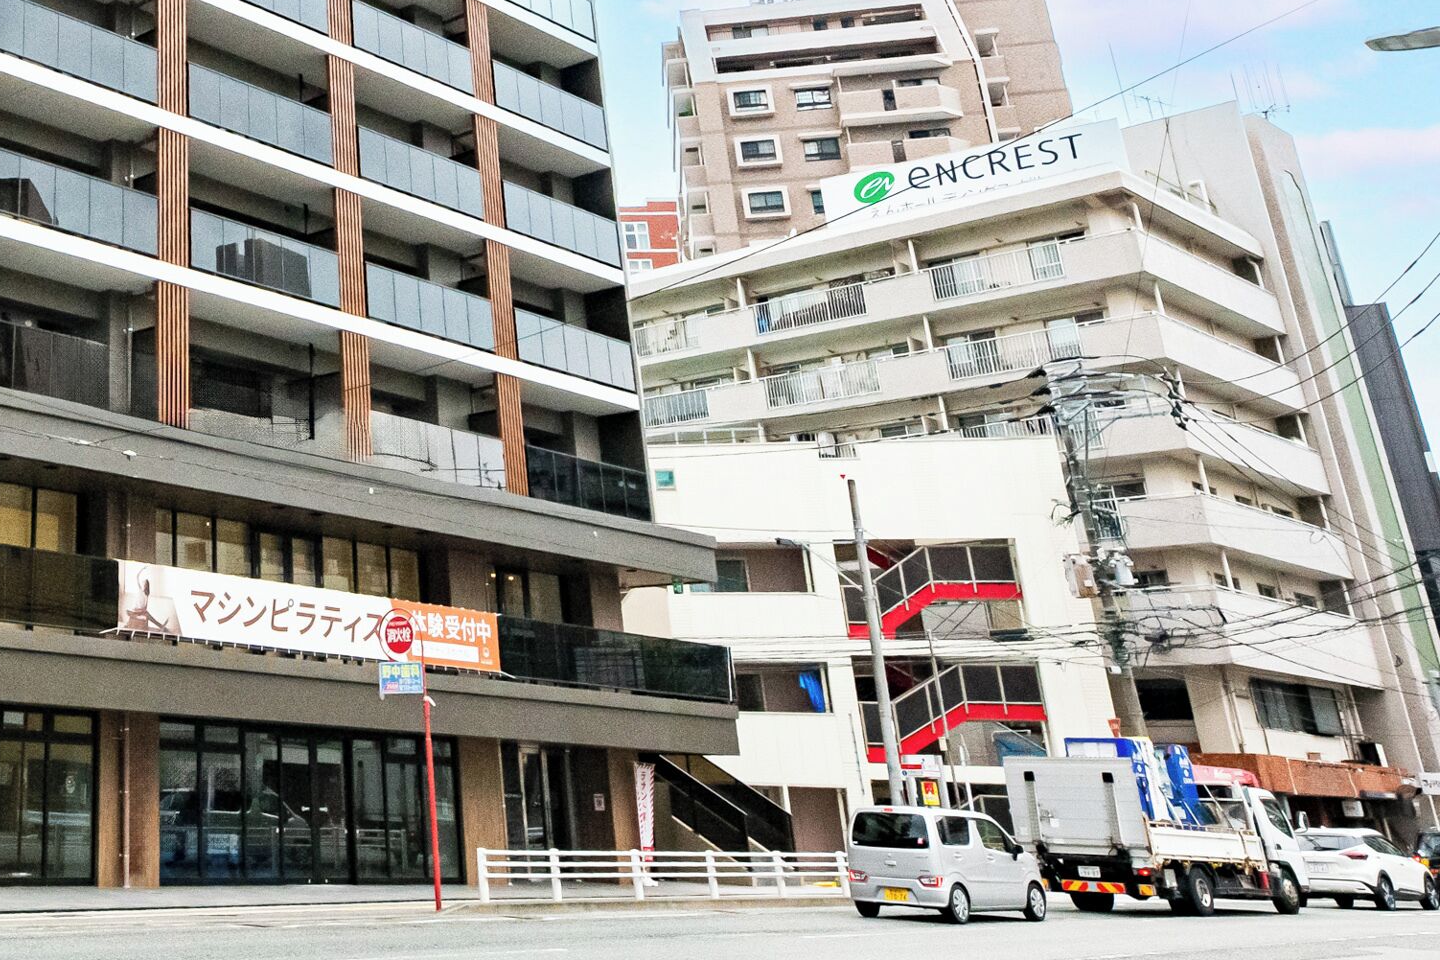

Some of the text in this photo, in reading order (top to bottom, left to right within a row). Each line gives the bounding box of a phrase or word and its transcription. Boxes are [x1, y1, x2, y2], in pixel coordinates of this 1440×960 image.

[190, 589, 383, 642] マシンピラティス
[411, 610, 491, 644] 体験受付中
[387, 627, 411, 643] 消火栓
